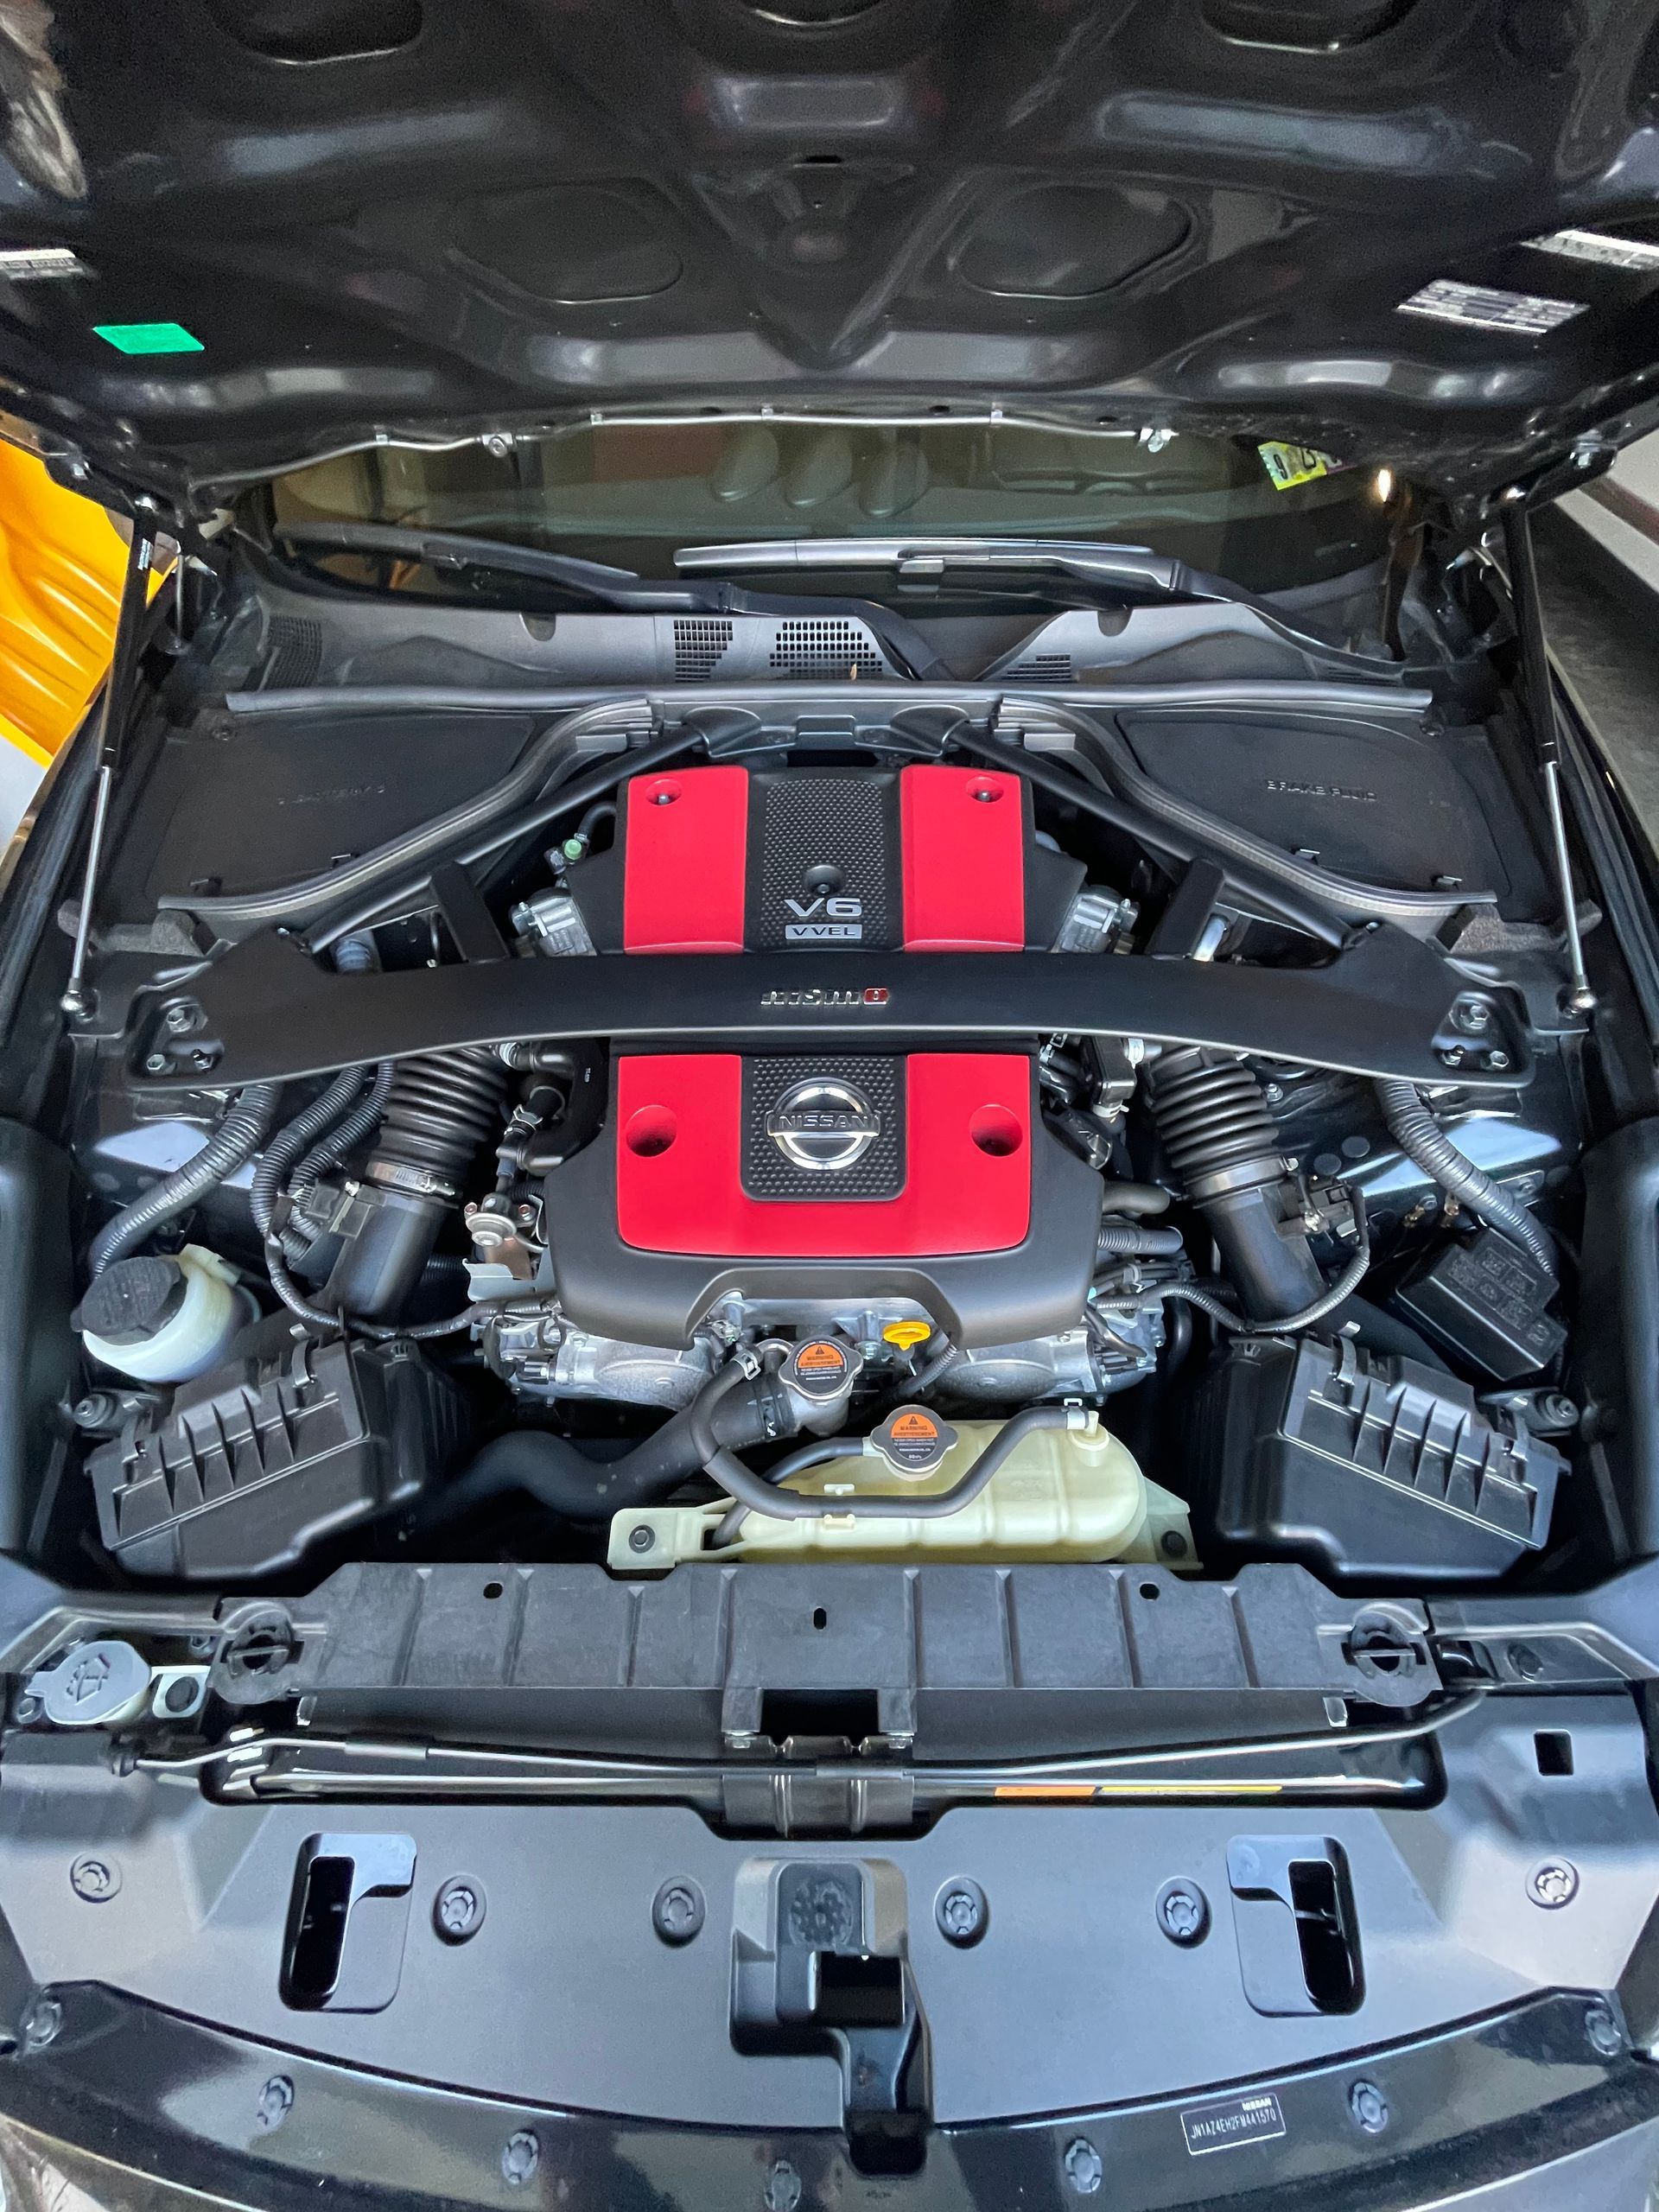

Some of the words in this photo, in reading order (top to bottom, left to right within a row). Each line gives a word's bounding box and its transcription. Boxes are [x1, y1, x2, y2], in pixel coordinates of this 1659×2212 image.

[784, 897, 862, 918] V6
[791, 926, 856, 937] VVEL
[779, 1115, 869, 1129] NISSAN
